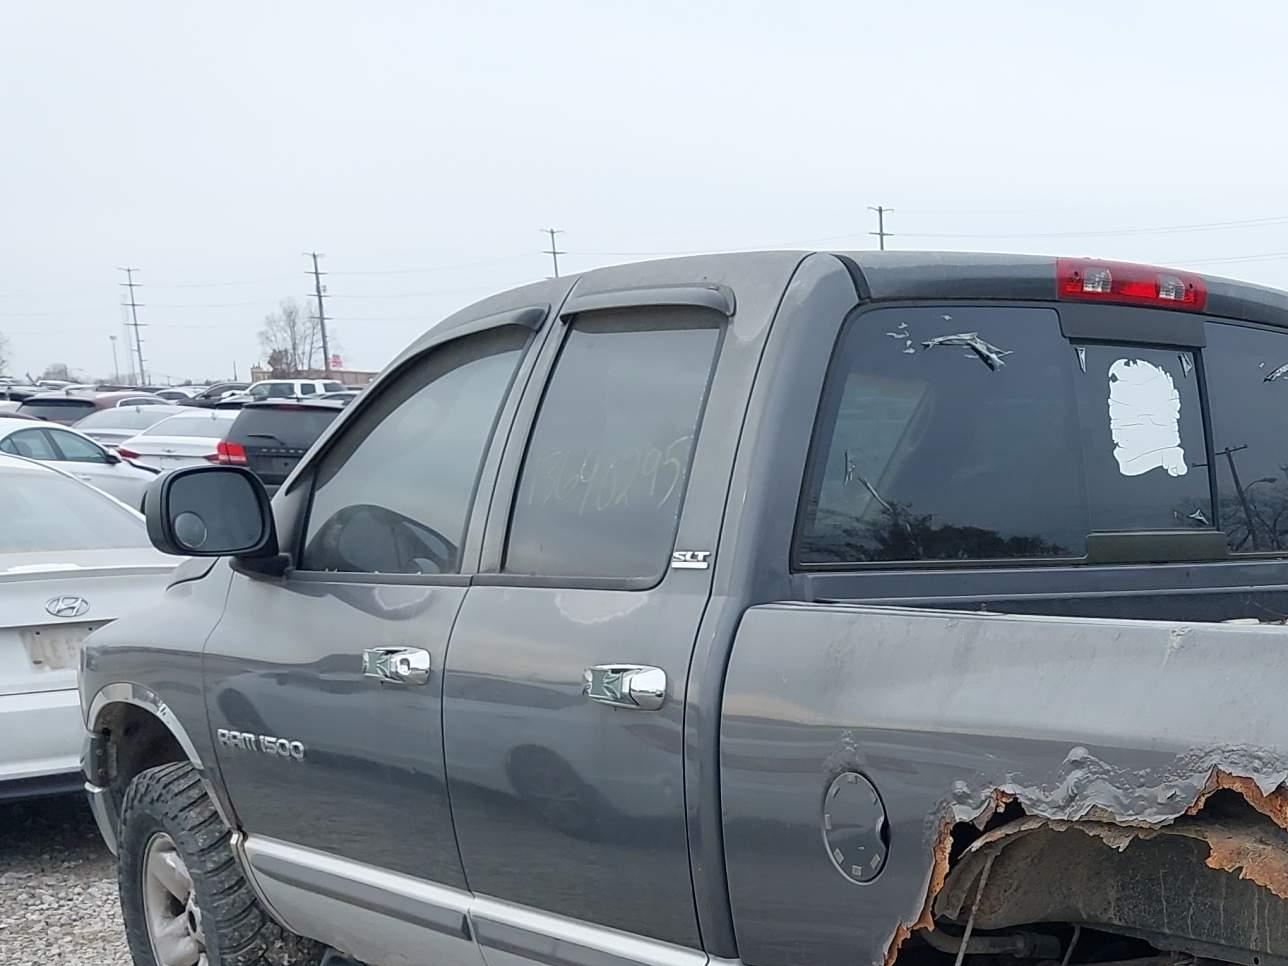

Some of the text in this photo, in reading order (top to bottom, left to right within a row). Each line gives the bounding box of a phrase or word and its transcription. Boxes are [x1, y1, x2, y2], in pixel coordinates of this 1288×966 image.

[672, 551, 711, 561] SLT
[217, 728, 305, 761] RAM 1500
